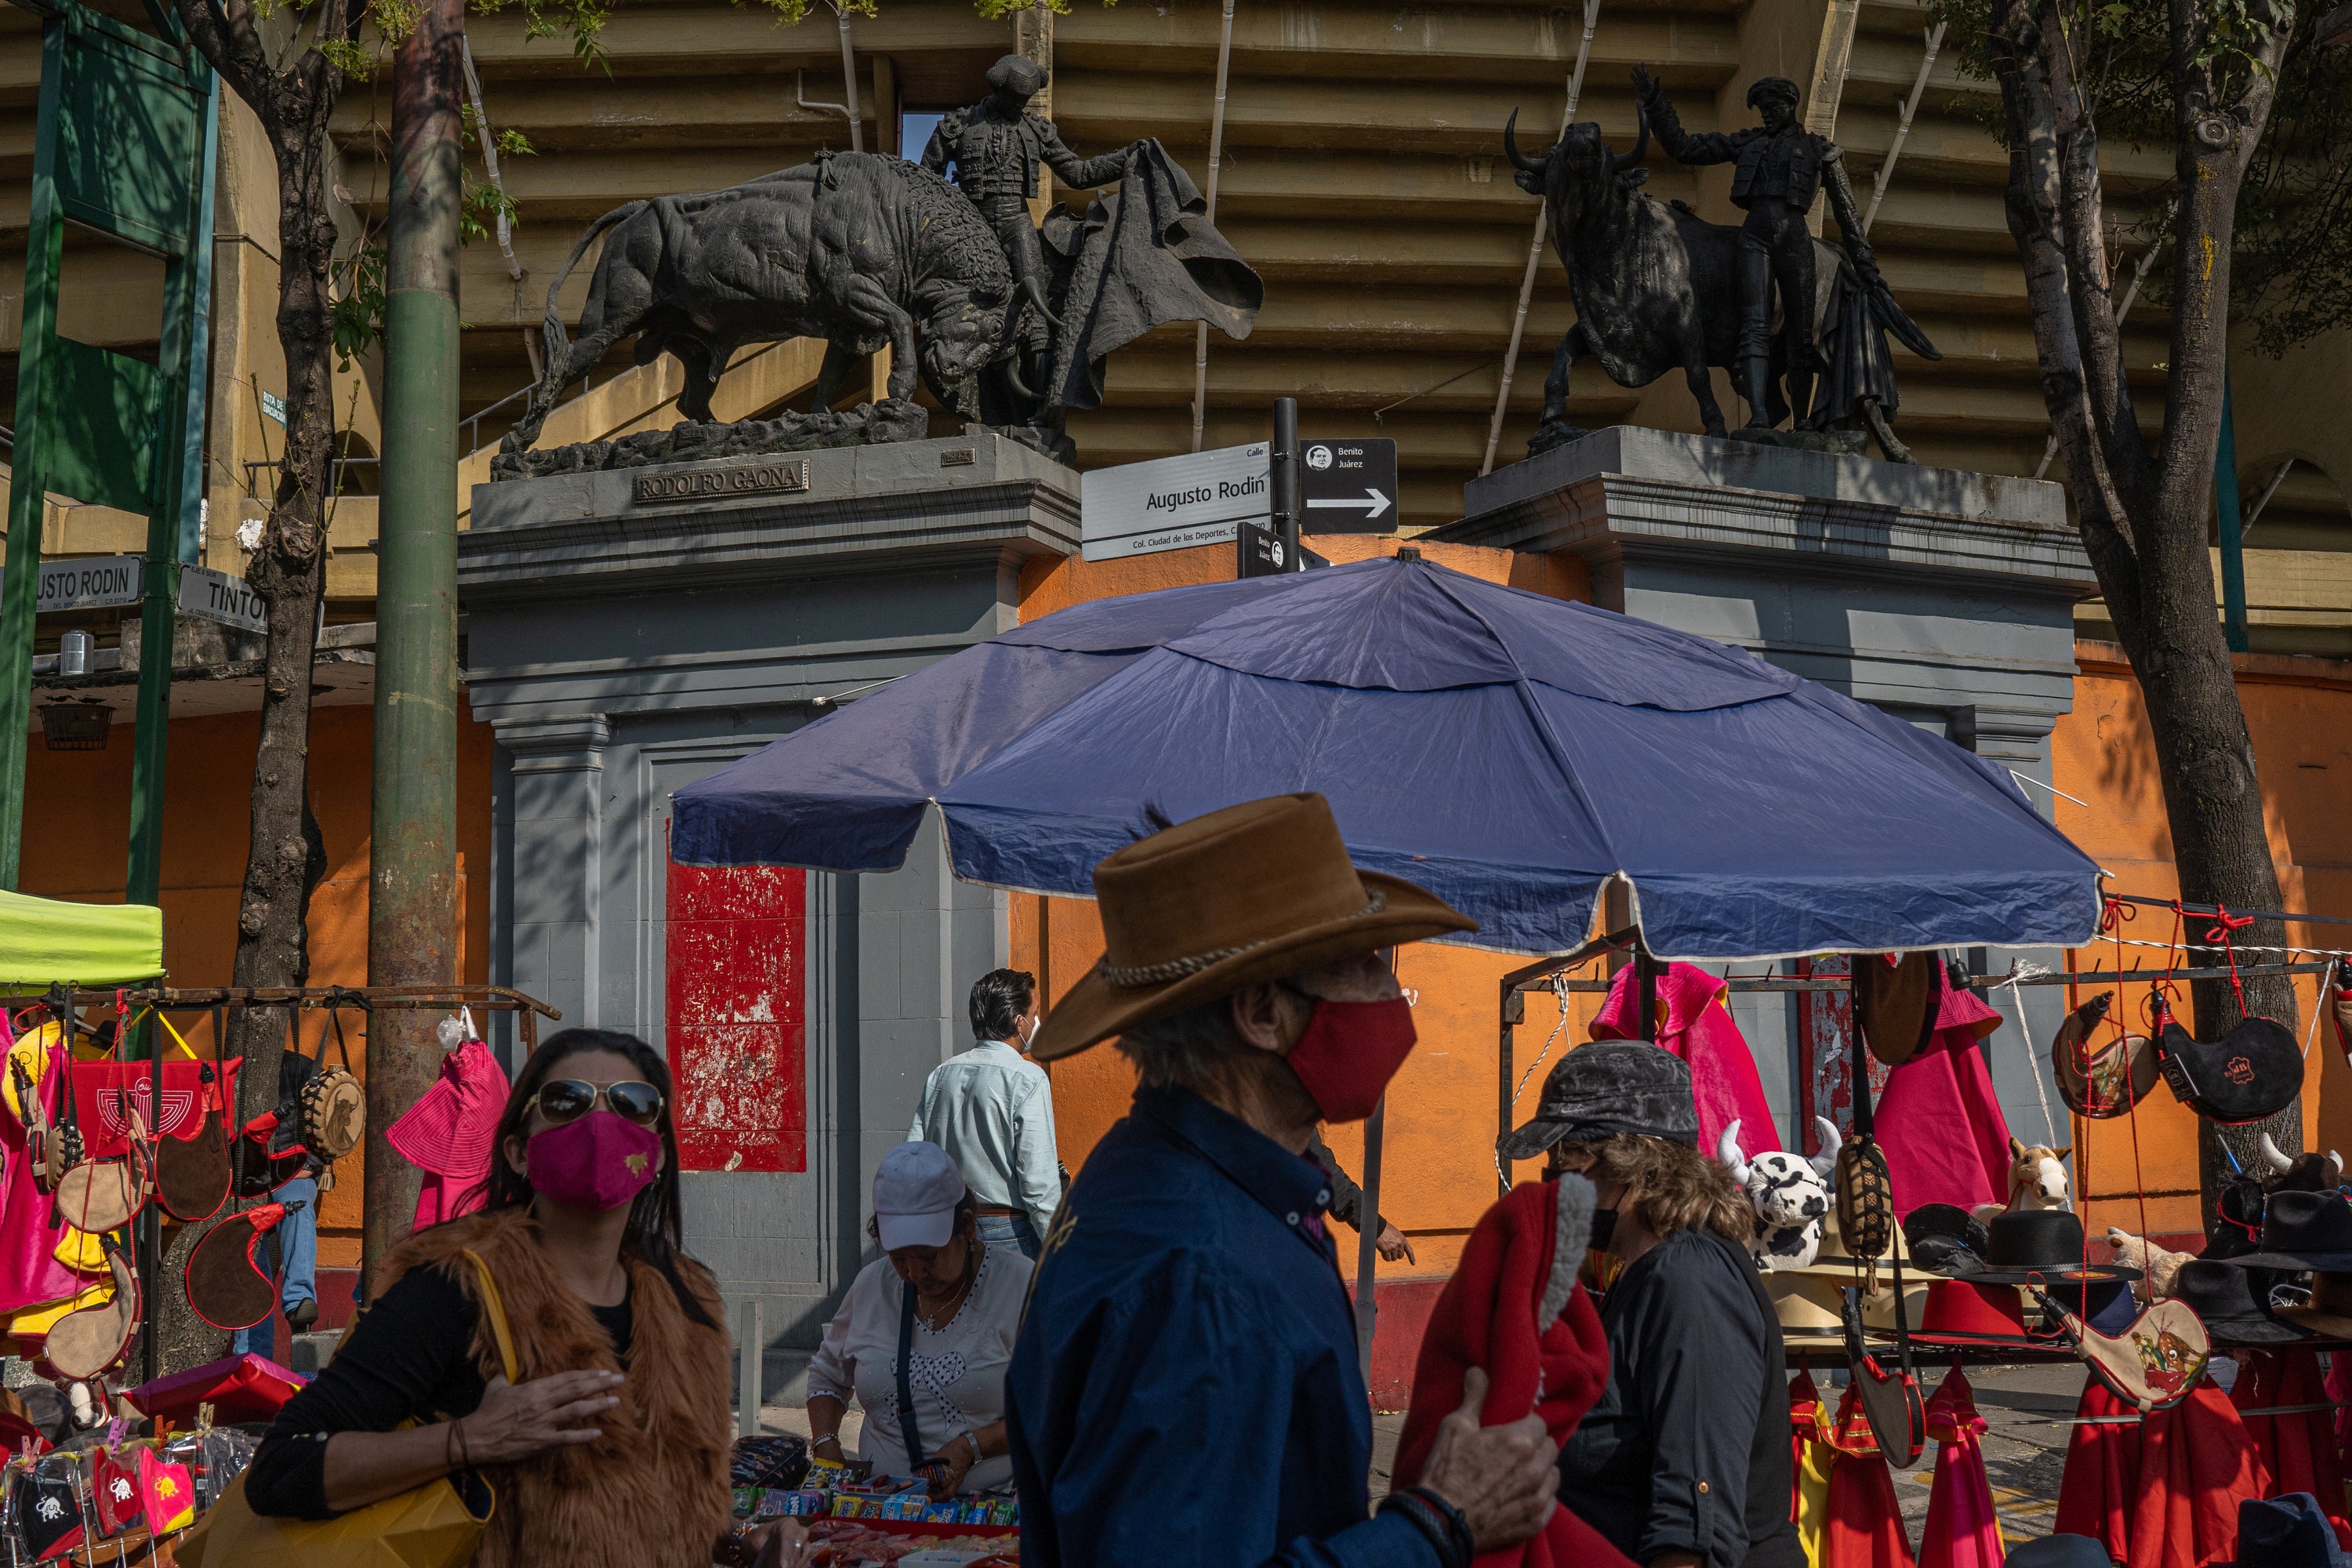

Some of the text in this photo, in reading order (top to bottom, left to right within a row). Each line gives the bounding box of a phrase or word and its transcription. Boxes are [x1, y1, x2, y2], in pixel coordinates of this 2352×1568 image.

[263, 391, 283, 411] RUTA DE
[1247, 448, 1264, 458] Calle
[1338, 447, 1363, 456] Benito
[1338, 459, 1363, 469] Juárez
[639, 466, 800, 498] RODOLFO GAONA
[1146, 486, 1211, 512] Augusto
[1148, 536, 1171, 546] Ciudad
[1173, 534, 1181, 543] de
[1183, 533, 1193, 542] los
[1196, 528, 1229, 541] Deportes,
[1258, 536, 1271, 548] Benito
[205, 570, 217, 579] SUR
[37, 567, 130, 600] USTO RODIN
[209, 582, 268, 622] TINTO
[195, 609, 209, 618] CIUDAD
[2234, 1063, 2248, 1073] JB
